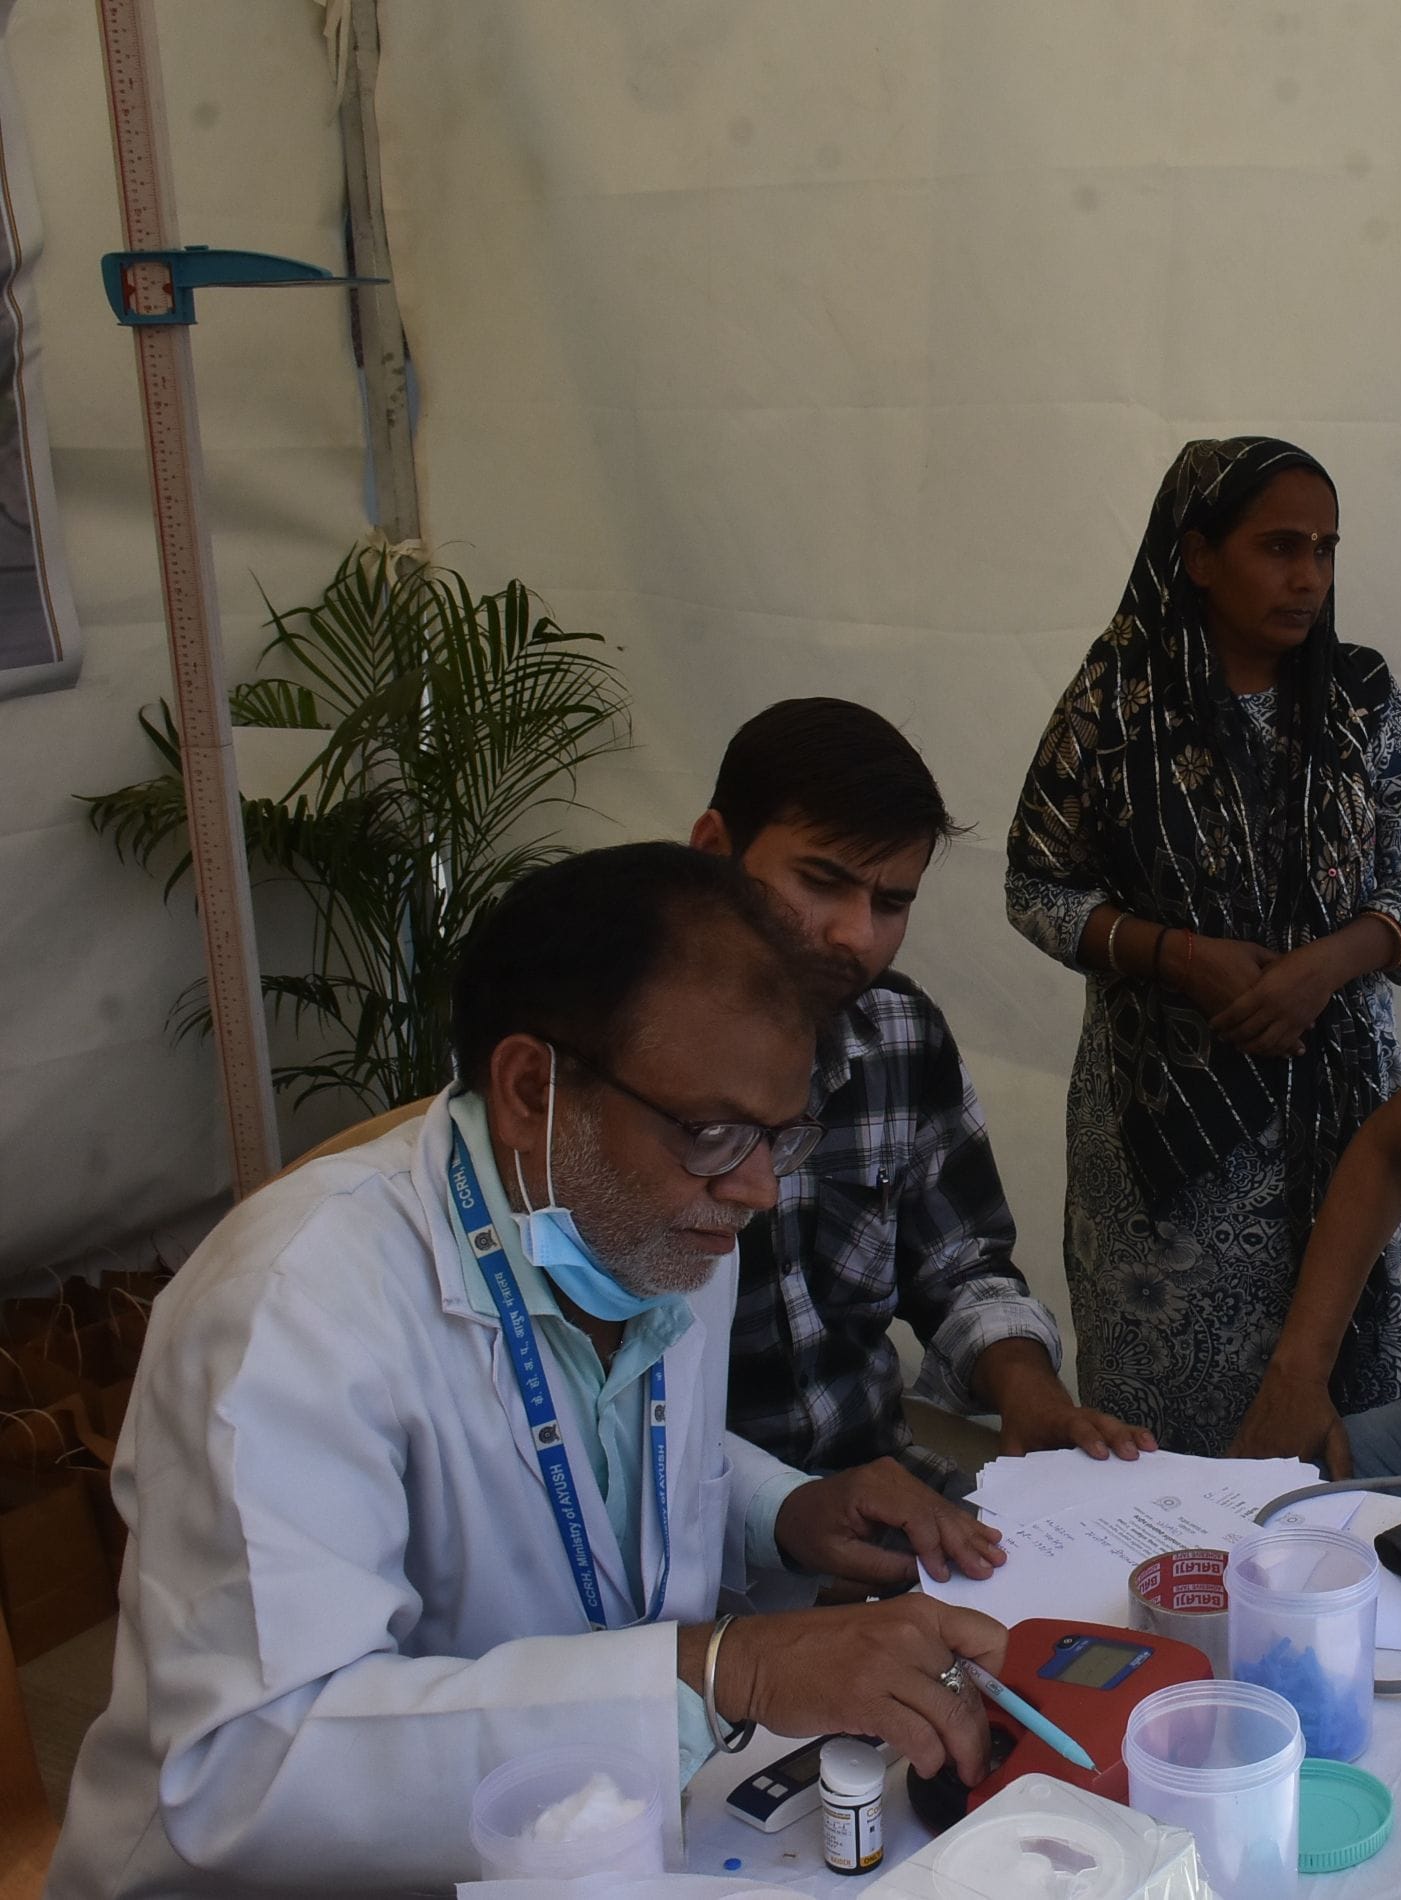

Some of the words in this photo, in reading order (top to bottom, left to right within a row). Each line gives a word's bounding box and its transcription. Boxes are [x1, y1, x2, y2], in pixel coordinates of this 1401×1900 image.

[550, 1464, 572, 1505] AYUSH
[562, 1506, 576, 1518] of
[568, 1522, 588, 1567] Ministry
[1175, 1562, 1220, 1574] BALAJI
[581, 1570, 598, 1608] CCRH,
[1176, 1594, 1220, 1606] BALAJI
